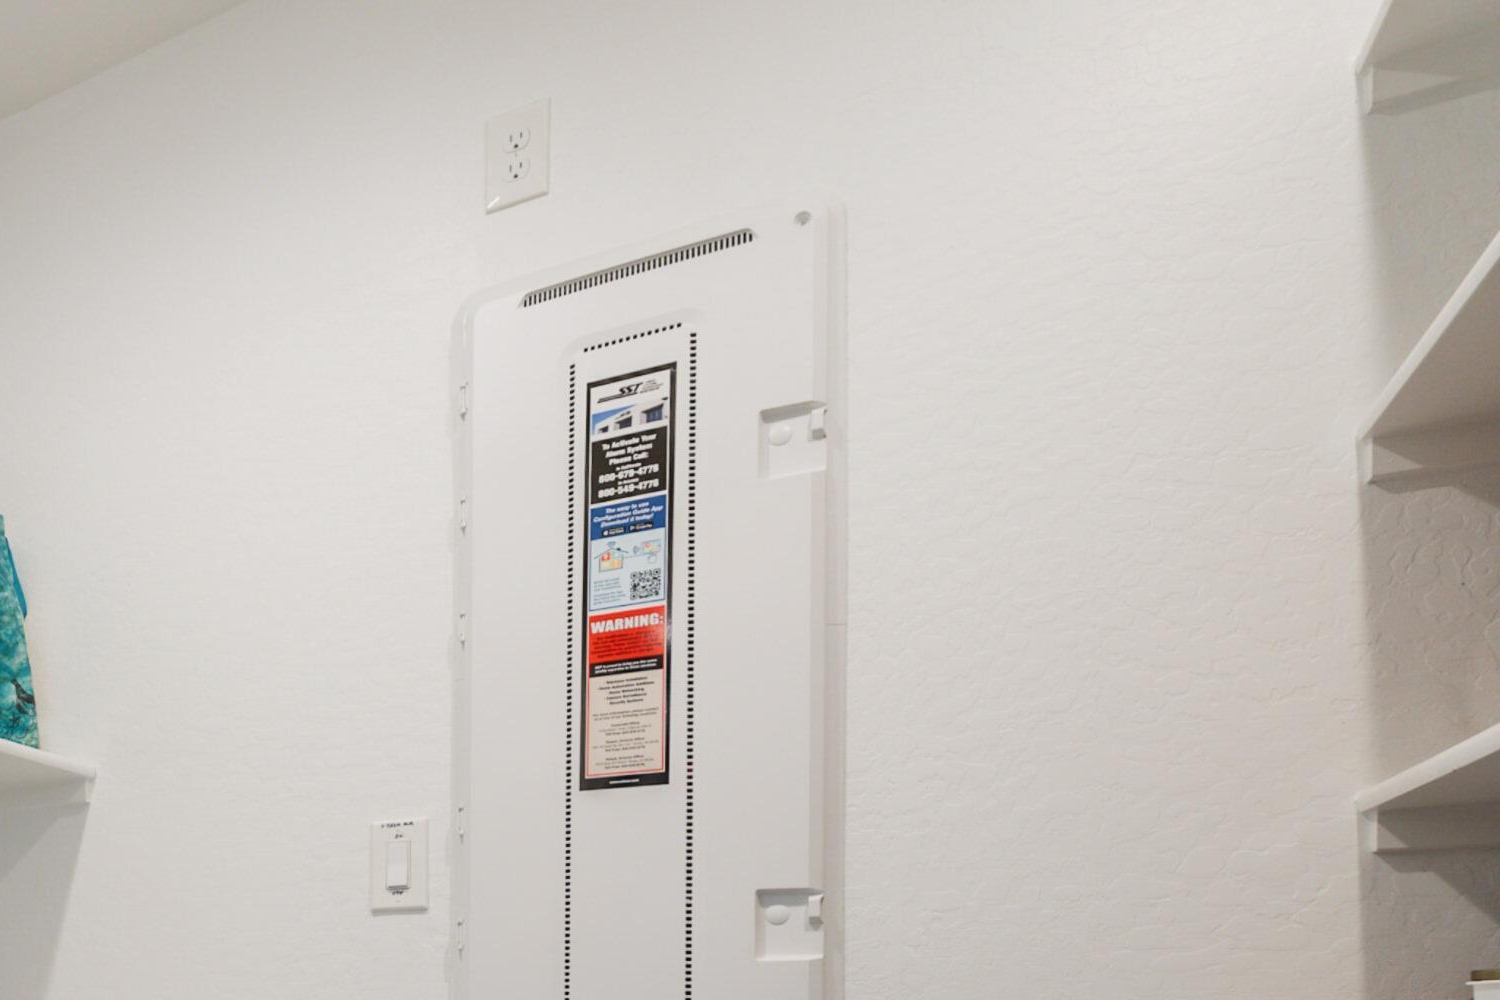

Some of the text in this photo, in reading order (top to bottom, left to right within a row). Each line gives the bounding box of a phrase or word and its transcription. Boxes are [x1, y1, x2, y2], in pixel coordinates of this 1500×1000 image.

[619, 381, 643, 395] SST
[611, 436, 640, 449] Activate
[641, 433, 657, 443] Your
[605, 443, 653, 458] Alarm System
[608, 451, 650, 466] Please Call:
[616, 505, 630, 513] easy
[632, 508, 650, 517] Guide
[651, 505, 663, 514] App
[600, 518, 629, 528] Download
[590, 612, 664, 634] WARNING:
